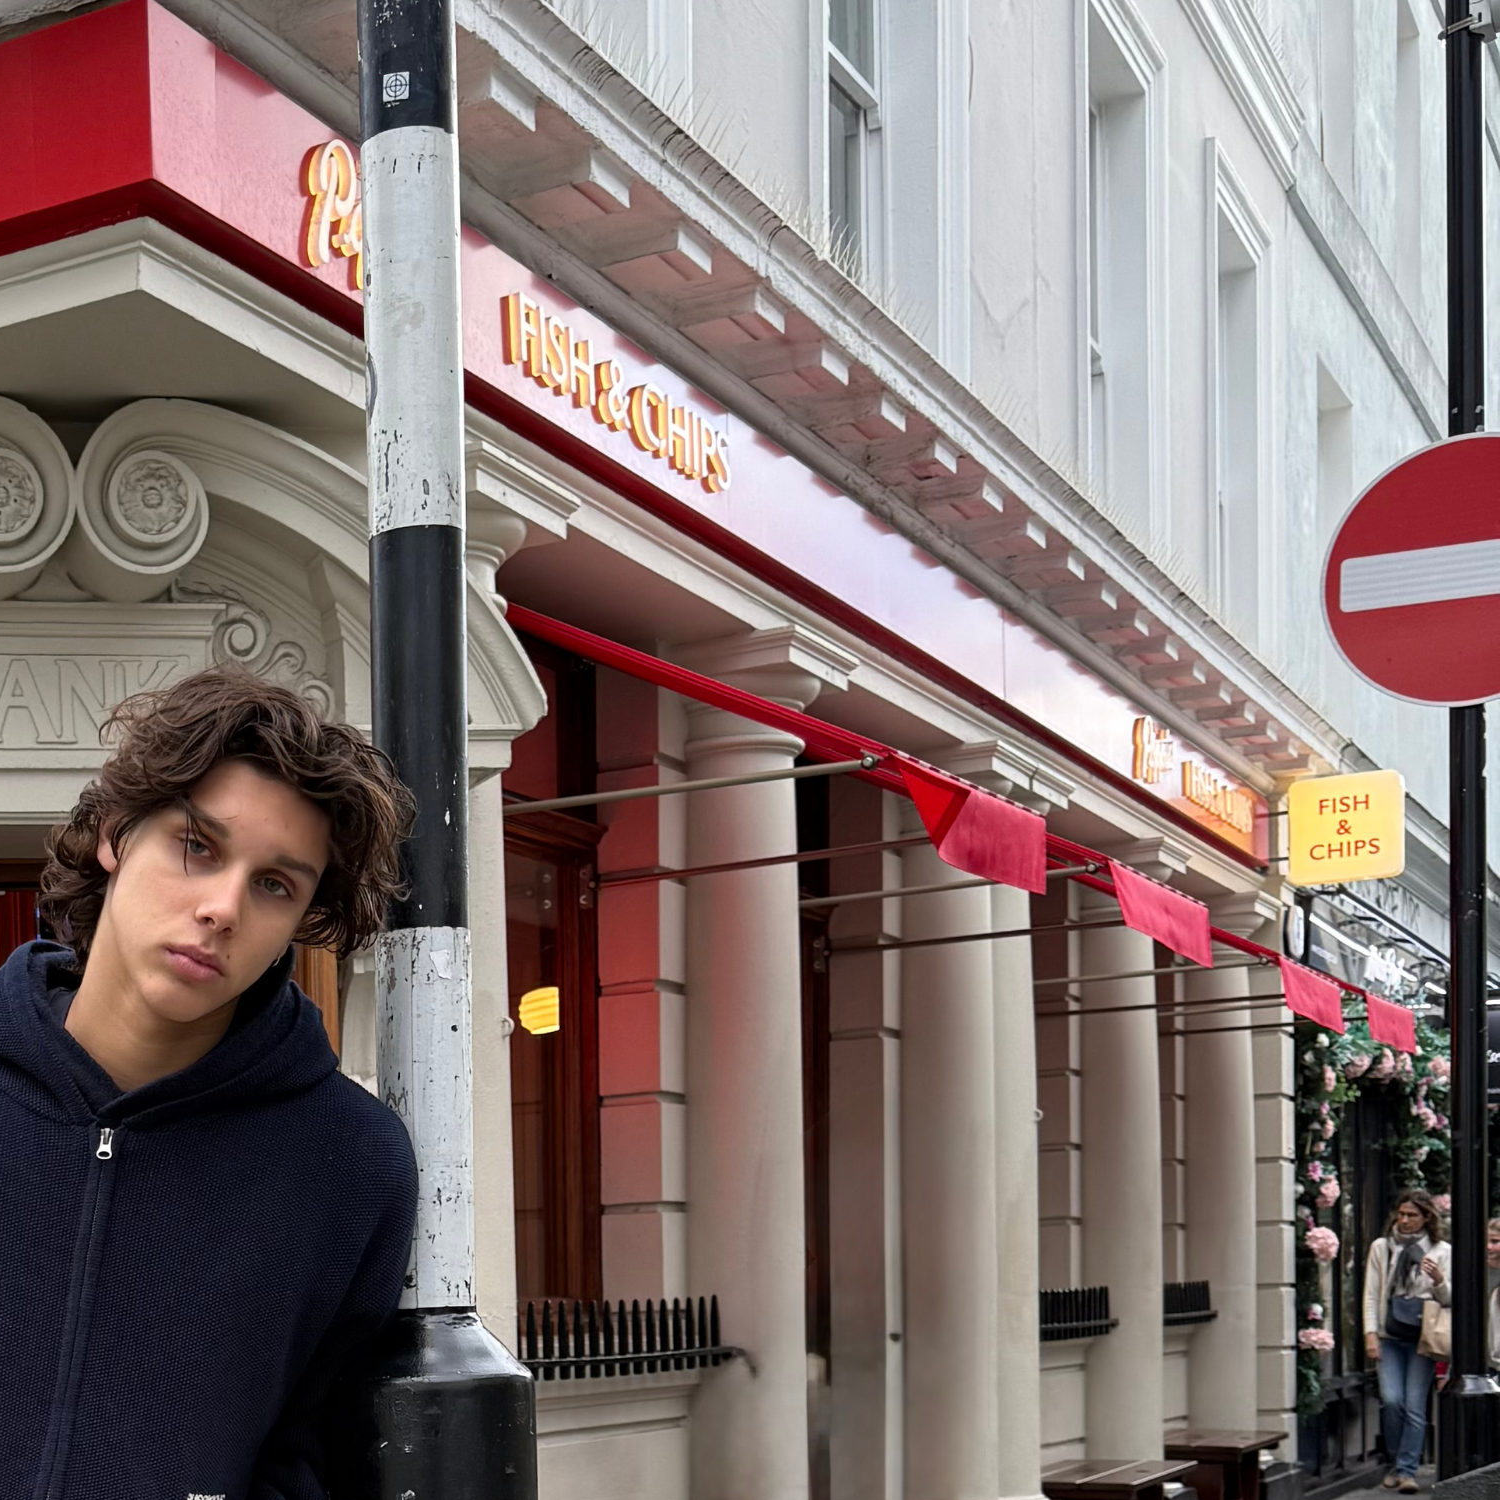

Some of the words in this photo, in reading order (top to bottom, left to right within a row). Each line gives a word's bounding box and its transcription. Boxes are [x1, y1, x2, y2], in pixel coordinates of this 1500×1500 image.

[499, 291, 596, 409] FISH
[591, 358, 632, 432] &
[626, 382, 731, 494] CHIPS
[1318, 793, 1370, 816] FISH
[1336, 819, 1353, 836] &
[1309, 837, 1381, 861] CHIPS
